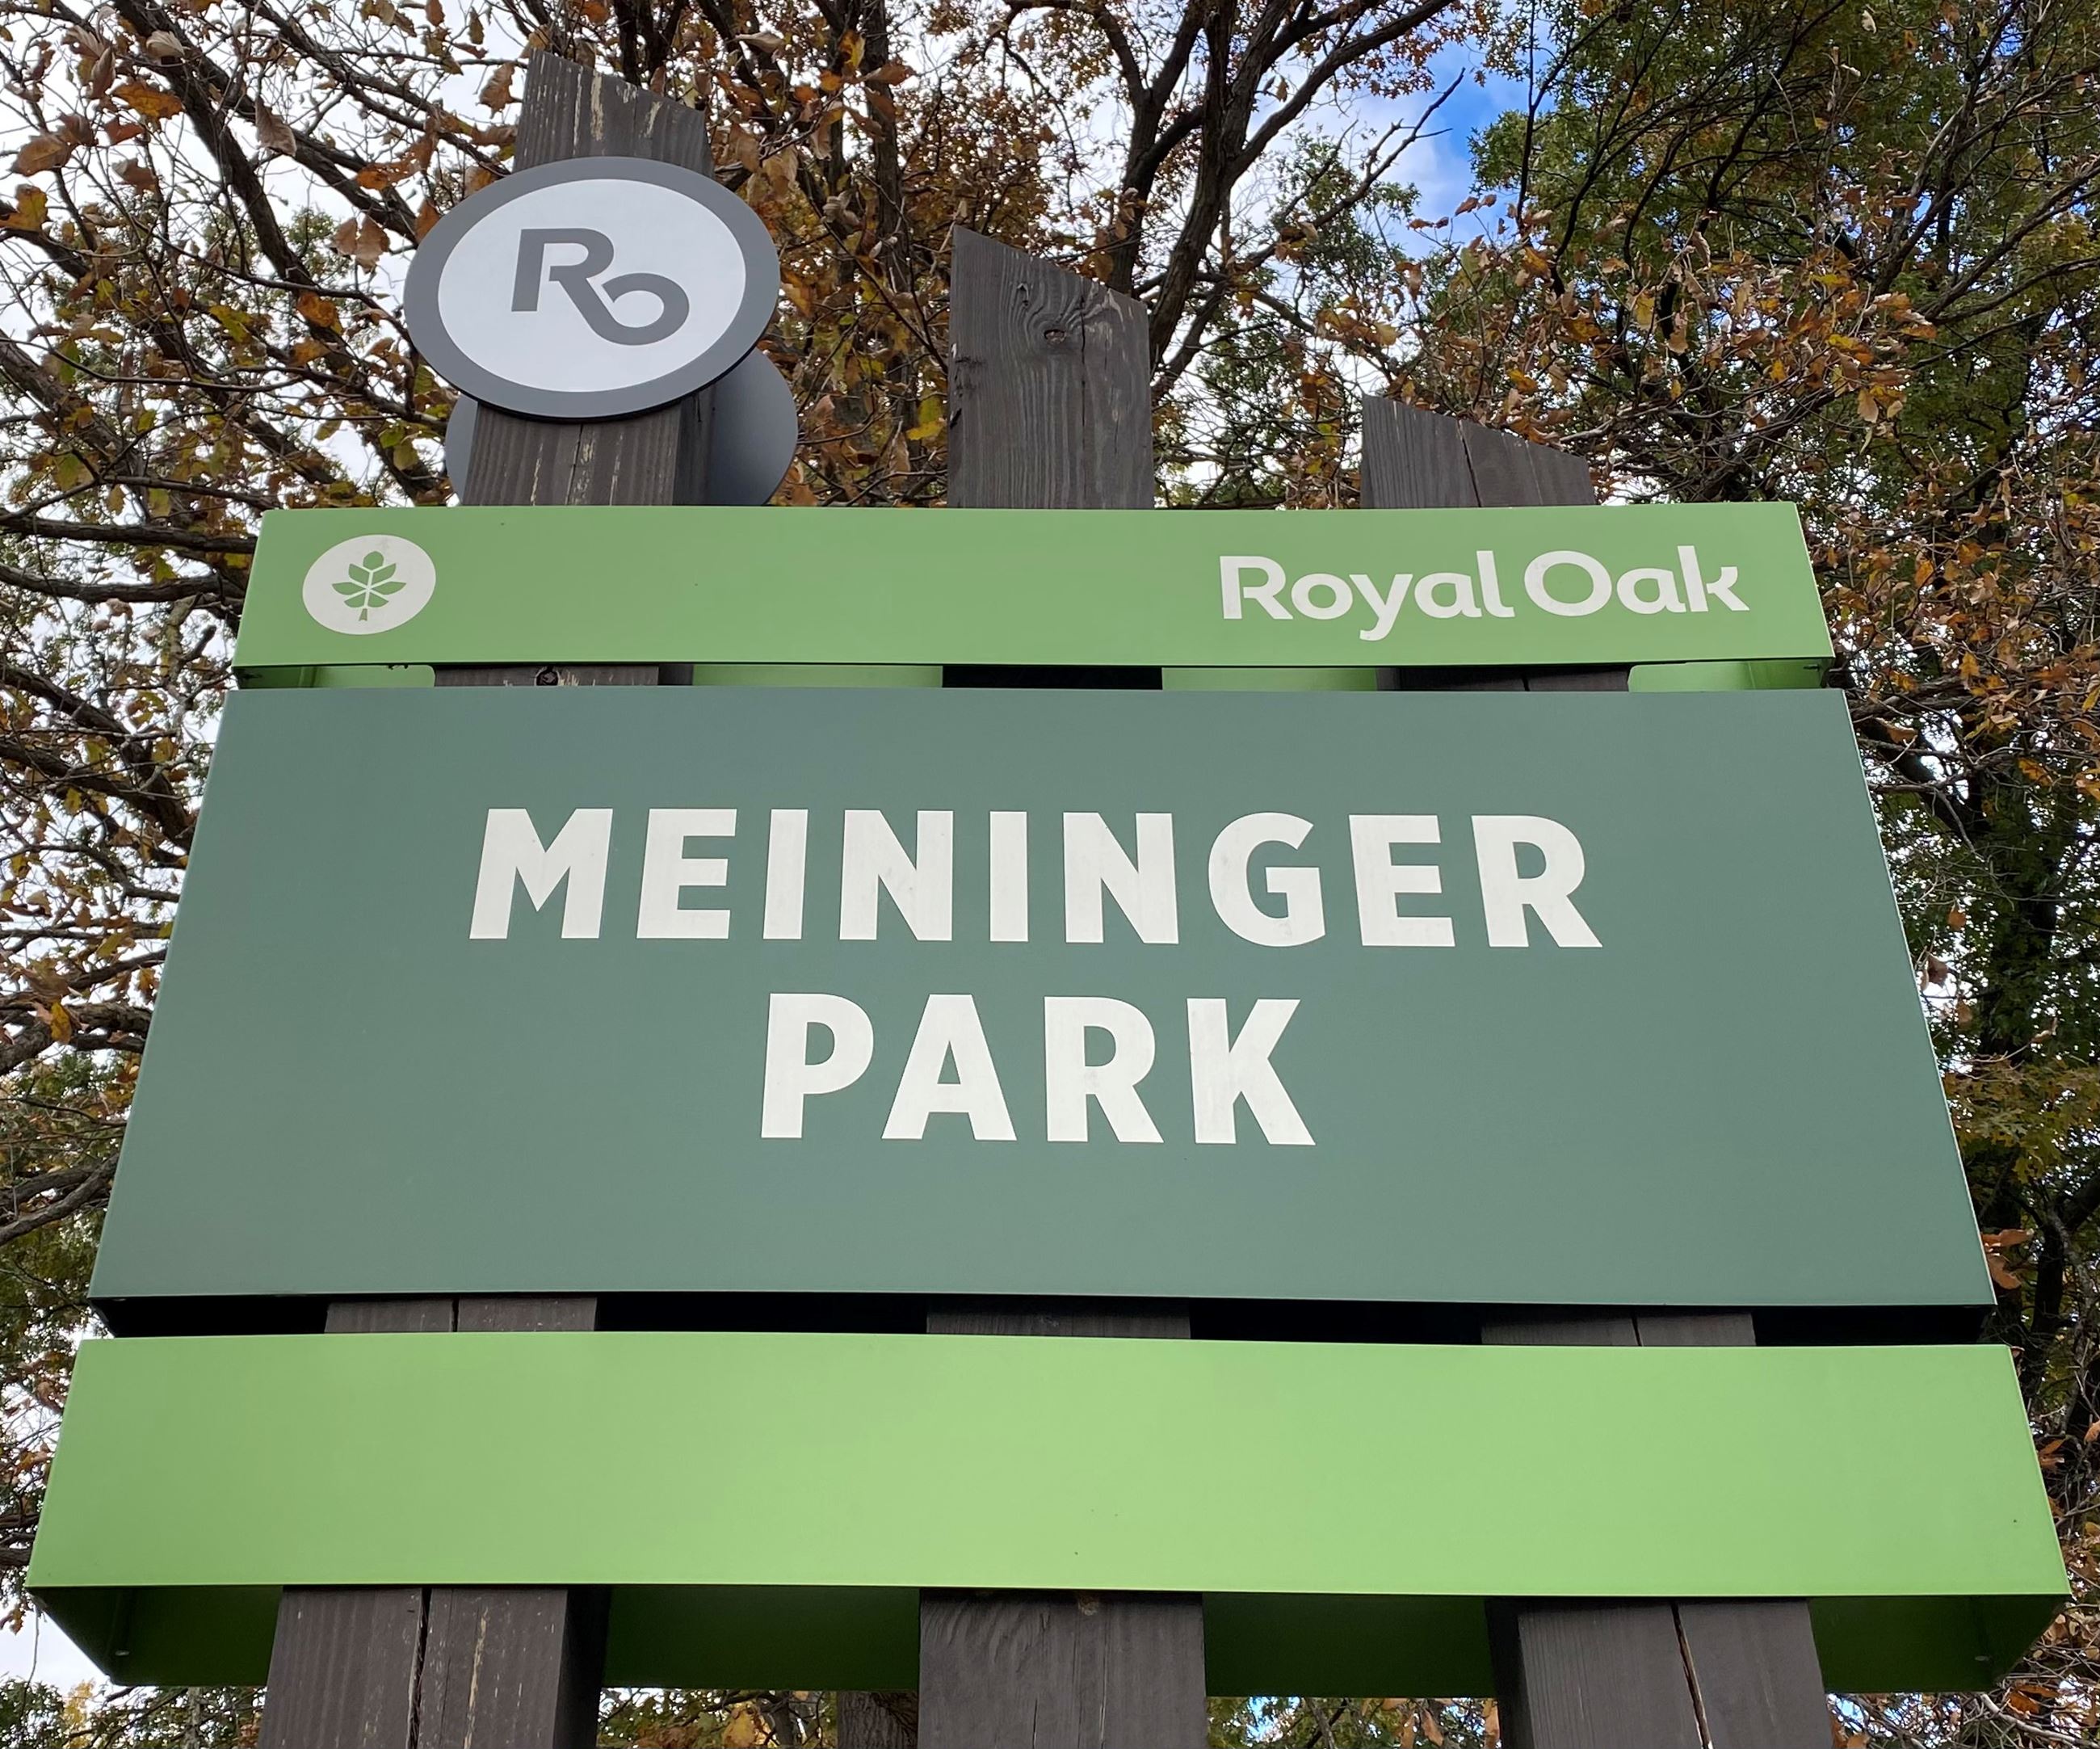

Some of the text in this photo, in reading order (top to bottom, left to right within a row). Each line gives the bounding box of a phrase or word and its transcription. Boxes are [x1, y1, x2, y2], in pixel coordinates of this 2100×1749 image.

[1220, 545, 1750, 641] Royal Oak
[468, 808, 1603, 948] MEININGER
[761, 993, 1317, 1146] PARK
